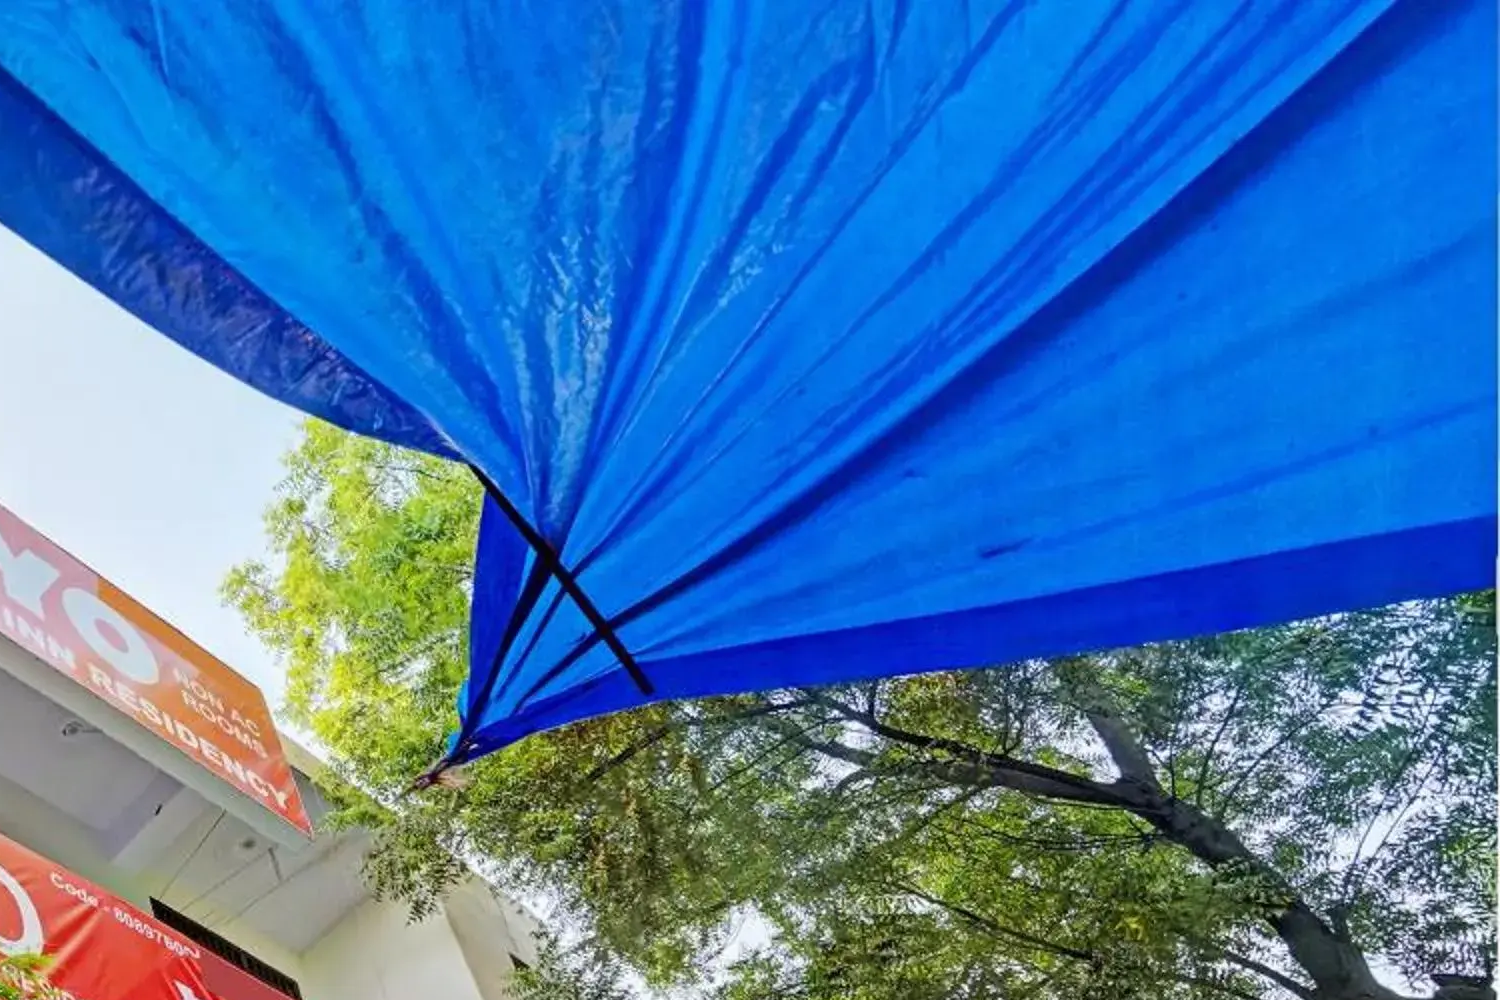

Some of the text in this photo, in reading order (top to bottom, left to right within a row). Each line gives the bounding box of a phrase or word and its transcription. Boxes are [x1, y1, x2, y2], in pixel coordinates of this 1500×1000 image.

[1, 605, 77, 672] INN
[87, 668, 288, 810] RESIDENCY
[49, 870, 99, 907] Code
